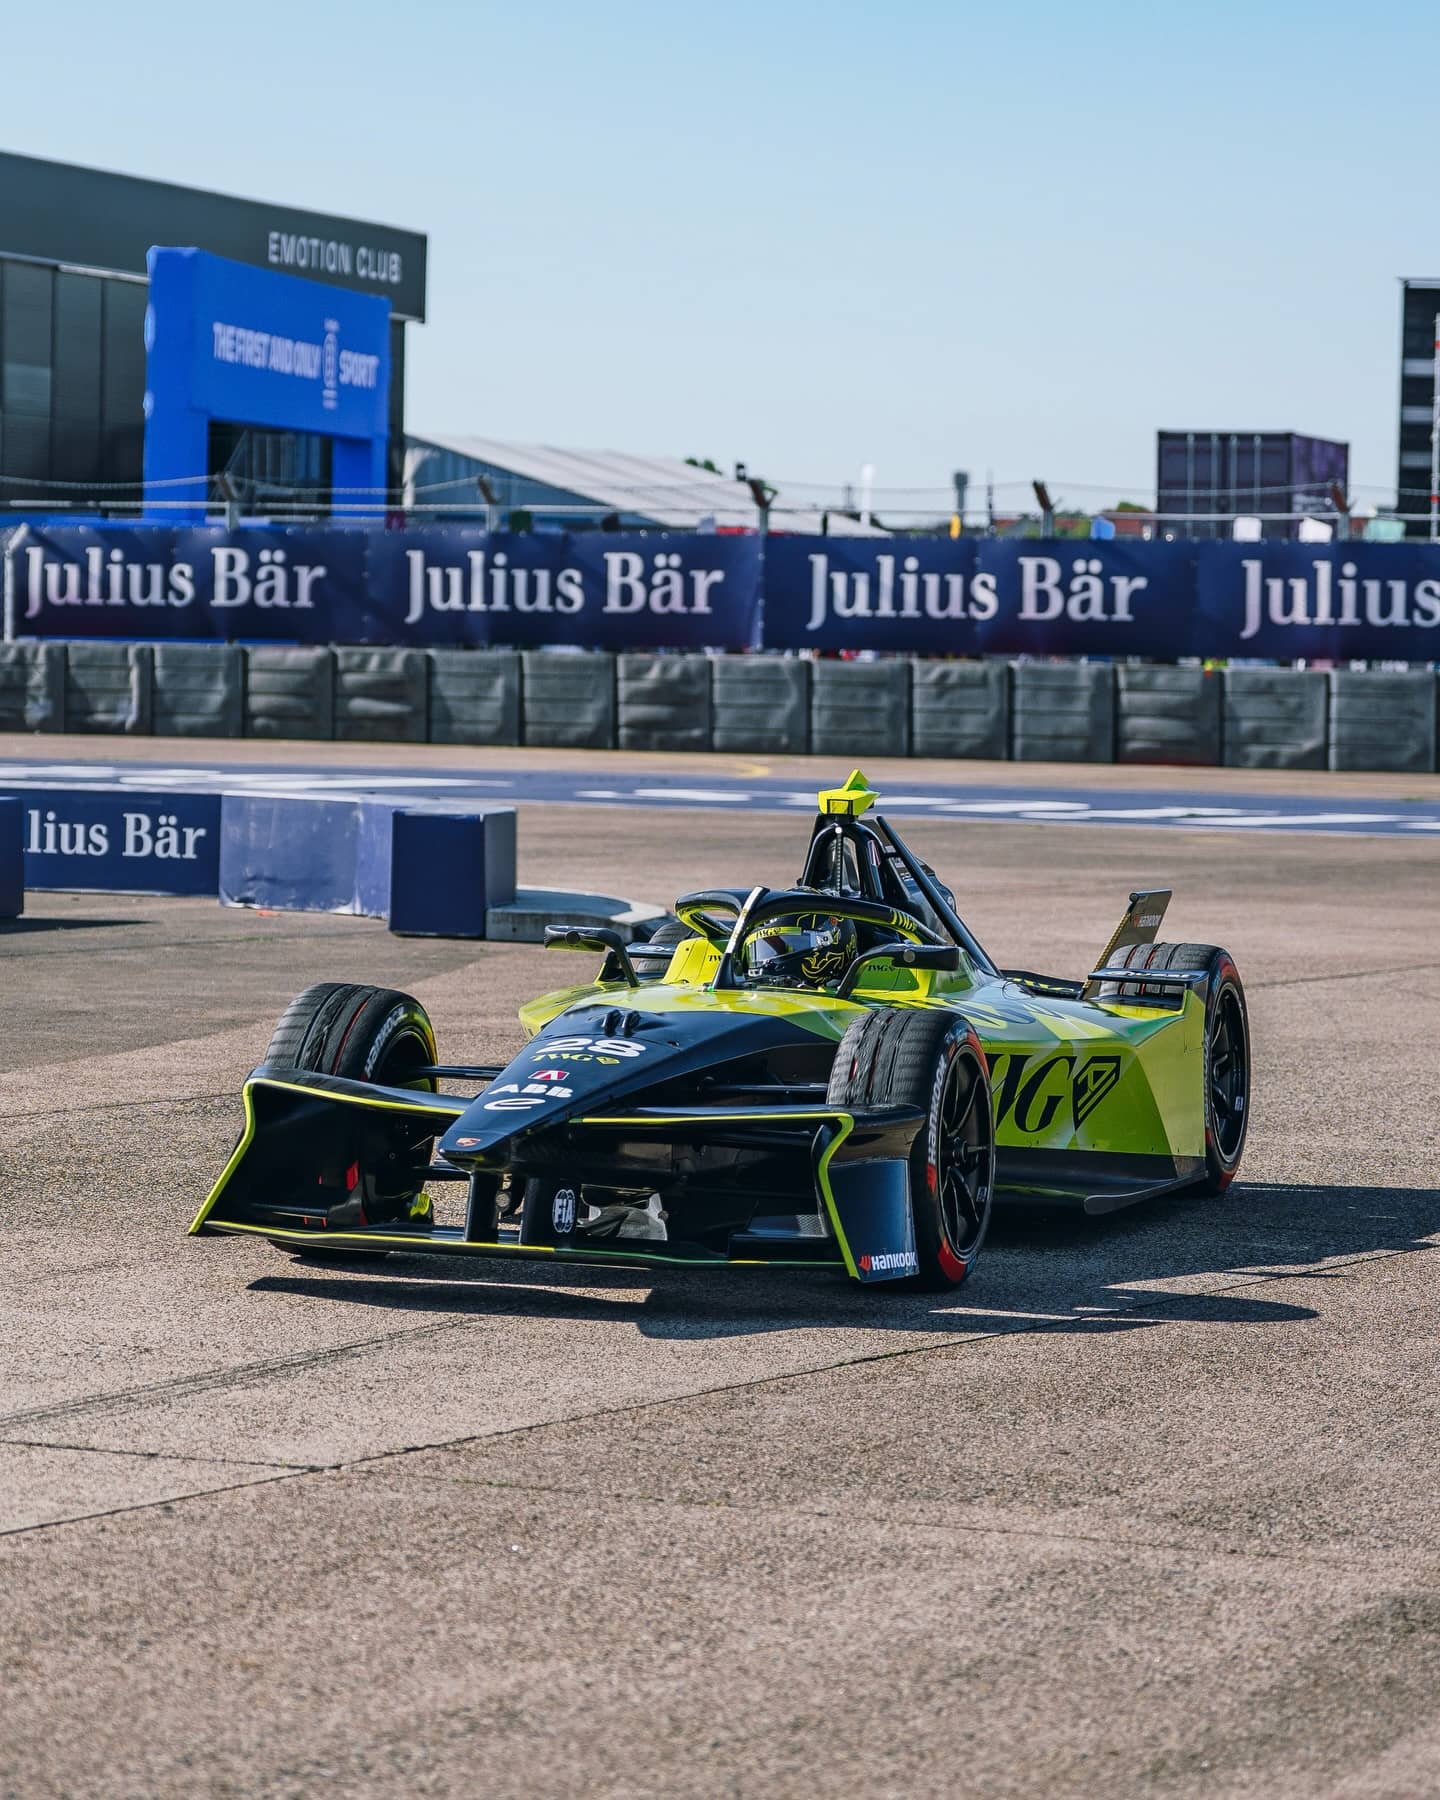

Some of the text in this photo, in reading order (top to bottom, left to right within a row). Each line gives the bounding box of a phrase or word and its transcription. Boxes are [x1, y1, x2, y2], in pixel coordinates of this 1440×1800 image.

[268, 231, 402, 283] EMOTION CLUB
[338, 350, 379, 388] SPORT
[25, 546, 327, 618] Julius Bär
[405, 550, 725, 624] Julius Bär
[807, 554, 1148, 631] Julius Bär
[1239, 559, 1440, 639] Julius
[27, 809, 206, 860] lius Bär
[488, 1083, 574, 1098] ABB
[985, 1053, 1077, 1132] WG
[555, 1198, 573, 1224] FIA
